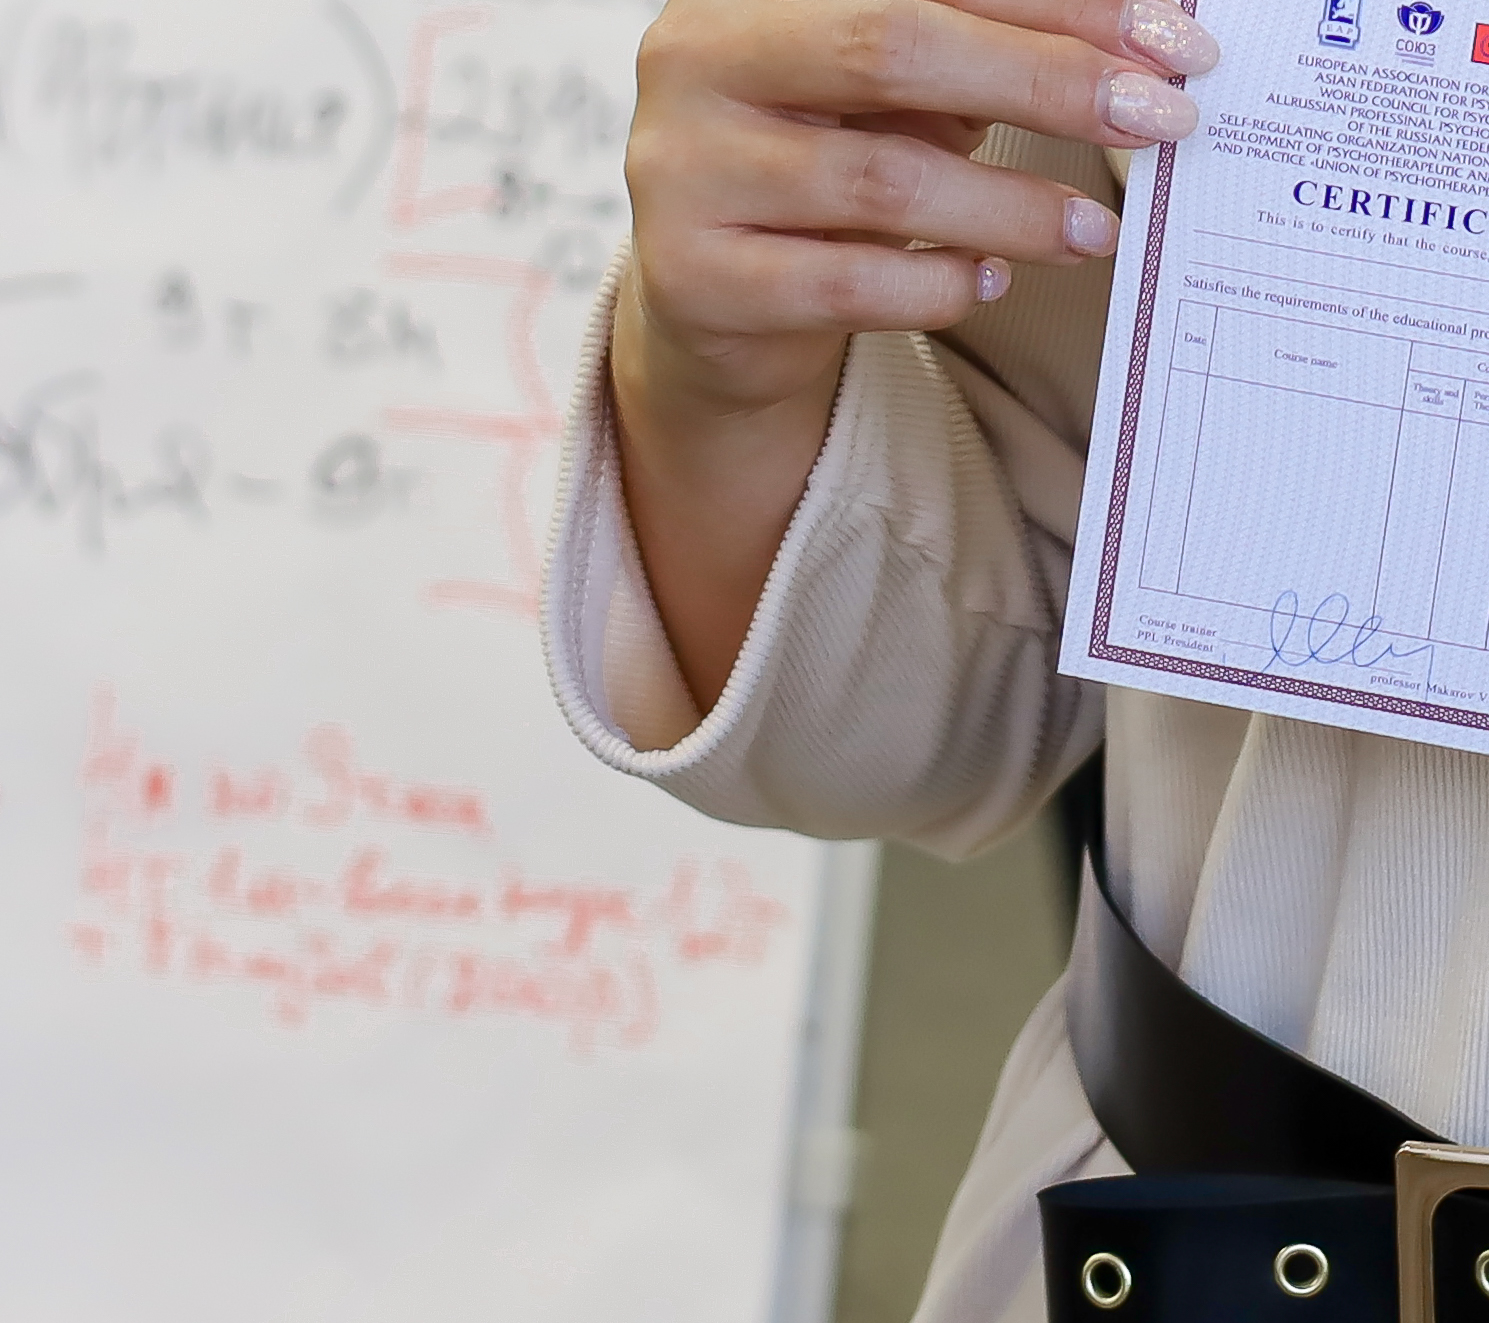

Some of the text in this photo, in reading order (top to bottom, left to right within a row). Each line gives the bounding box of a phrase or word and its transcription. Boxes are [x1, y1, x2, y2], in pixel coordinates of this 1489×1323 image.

[1394, 37, 1436, 56] СОЮЗ
[1297, 53, 1368, 76] EUROPEAN
[1371, 66, 1461, 91] ASSOCIATION
[1463, 81, 1489, 96] FOR
[1313, 71, 1357, 88] ASIAN
[1359, 78, 1439, 102] FEDERATION
[1441, 91, 1467, 107] FOR
[1264, 91, 1346, 116] ALLRUSSIAN
[1349, 105, 1434, 130] PROFESSINAL
[1319, 85, 1368, 104] WORLD
[1370, 94, 1430, 115] COUNCIL
[1433, 105, 1459, 120] FOR
[1207, 124, 1303, 151] DEVELOPMENT
[1305, 142, 1323, 155] OF
[1326, 145, 1463, 178] PSYCHOTHERAPEUTIC
[1218, 112, 1333, 142] SELF-REGULATING
[1335, 132, 1438, 159] ORGANIZATION
[1346, 119, 1365, 133] OF
[1368, 122, 1391, 137] THE
[1395, 128, 1452, 148] RUSSIAN
[1211, 140, 1243, 155] AND
[1245, 145, 1305, 167] PRACTICE
[1362, 166, 1381, 179] OF
[1256, 209, 1286, 226] This
[1292, 215, 1304, 229] is
[1310, 220, 1324, 232] to
[1329, 225, 1376, 244] certify
[1382, 231, 1408, 247] that
[1414, 236, 1436, 252] the
[1182, 274, 1237, 295] Satisfies
[1240, 284, 1261, 300] the
[1263, 292, 1348, 315] requirements
[1351, 305, 1368, 318] of
[1368, 307, 1389, 323] the
[1391, 312, 1467, 335] educational
[1183, 331, 1207, 346] Date
[1273, 348, 1308, 364] Course
[1443, 388, 1459, 399] and
[1136, 629, 1213, 652] PPL President
[1138, 614, 1217, 637] Course trainer
[1369, 674, 1421, 690] professor
[1425, 682, 1475, 699] Makarov
